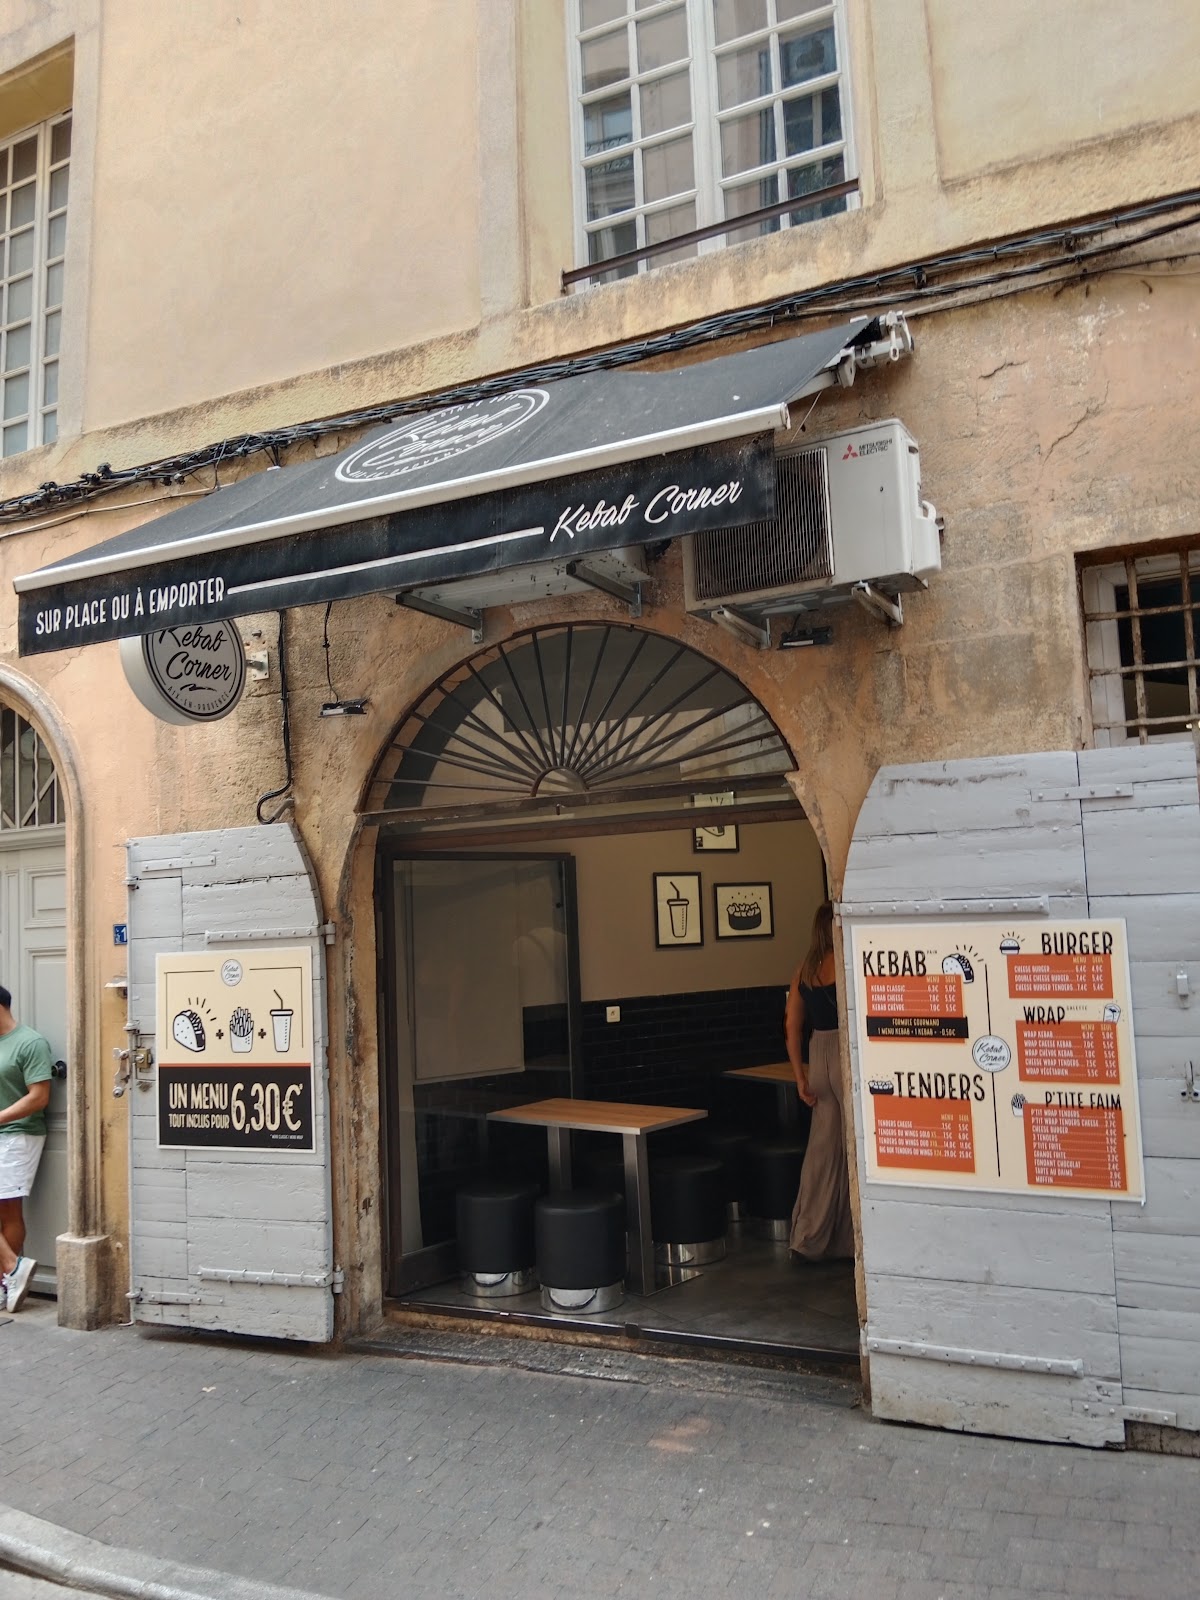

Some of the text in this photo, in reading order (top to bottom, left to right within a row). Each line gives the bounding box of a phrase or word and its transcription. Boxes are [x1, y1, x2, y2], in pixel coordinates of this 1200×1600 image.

[859, 438, 892, 450] MITSUBISHI
[860, 446, 888, 456] ELECTRIC
[550, 480, 743, 542] Kebab Corner
[35, 576, 225, 635] SUR PLACE OU À EMPORTER
[166, 651, 232, 680] Corner
[168, 686, 229, 711] AIX-EN-PROVENCE
[1041, 931, 1113, 956] BURGER
[862, 950, 927, 977] KEBAB
[1015, 974, 1032, 982] DOUBLE
[1033, 974, 1050, 982] CHEESE
[1051, 974, 1069, 982] BURGER
[1016, 983, 1032, 991] CHEESE
[1033, 983, 1051, 991] BURGER
[1052, 983, 1073, 991] TENDERS
[872, 994, 886, 1002] KEBAB
[887, 994, 903, 1002] CHEESE
[1023, 1006, 1065, 1025] WRAP
[977, 1042, 1003, 1053] Kebab
[980, 1053, 1006, 1062] Corner
[1025, 1058, 1042, 1066] CHEESE
[1058, 1059, 1080, 1067] TENDERS
[894, 1071, 985, 1102] TENDERS
[169, 1083, 188, 1109] UN
[191, 1083, 228, 1110] MENU
[1045, 1091, 1122, 1111] P'TITE FAIM
[168, 1114, 230, 1129] TOUT INCLUS POUR
[878, 1120, 896, 1128] TENDERS
[878, 1128, 897, 1137] TENDERS
[1032, 1125, 1050, 1133] CHEESE
[879, 1137, 897, 1145] TENDERS
